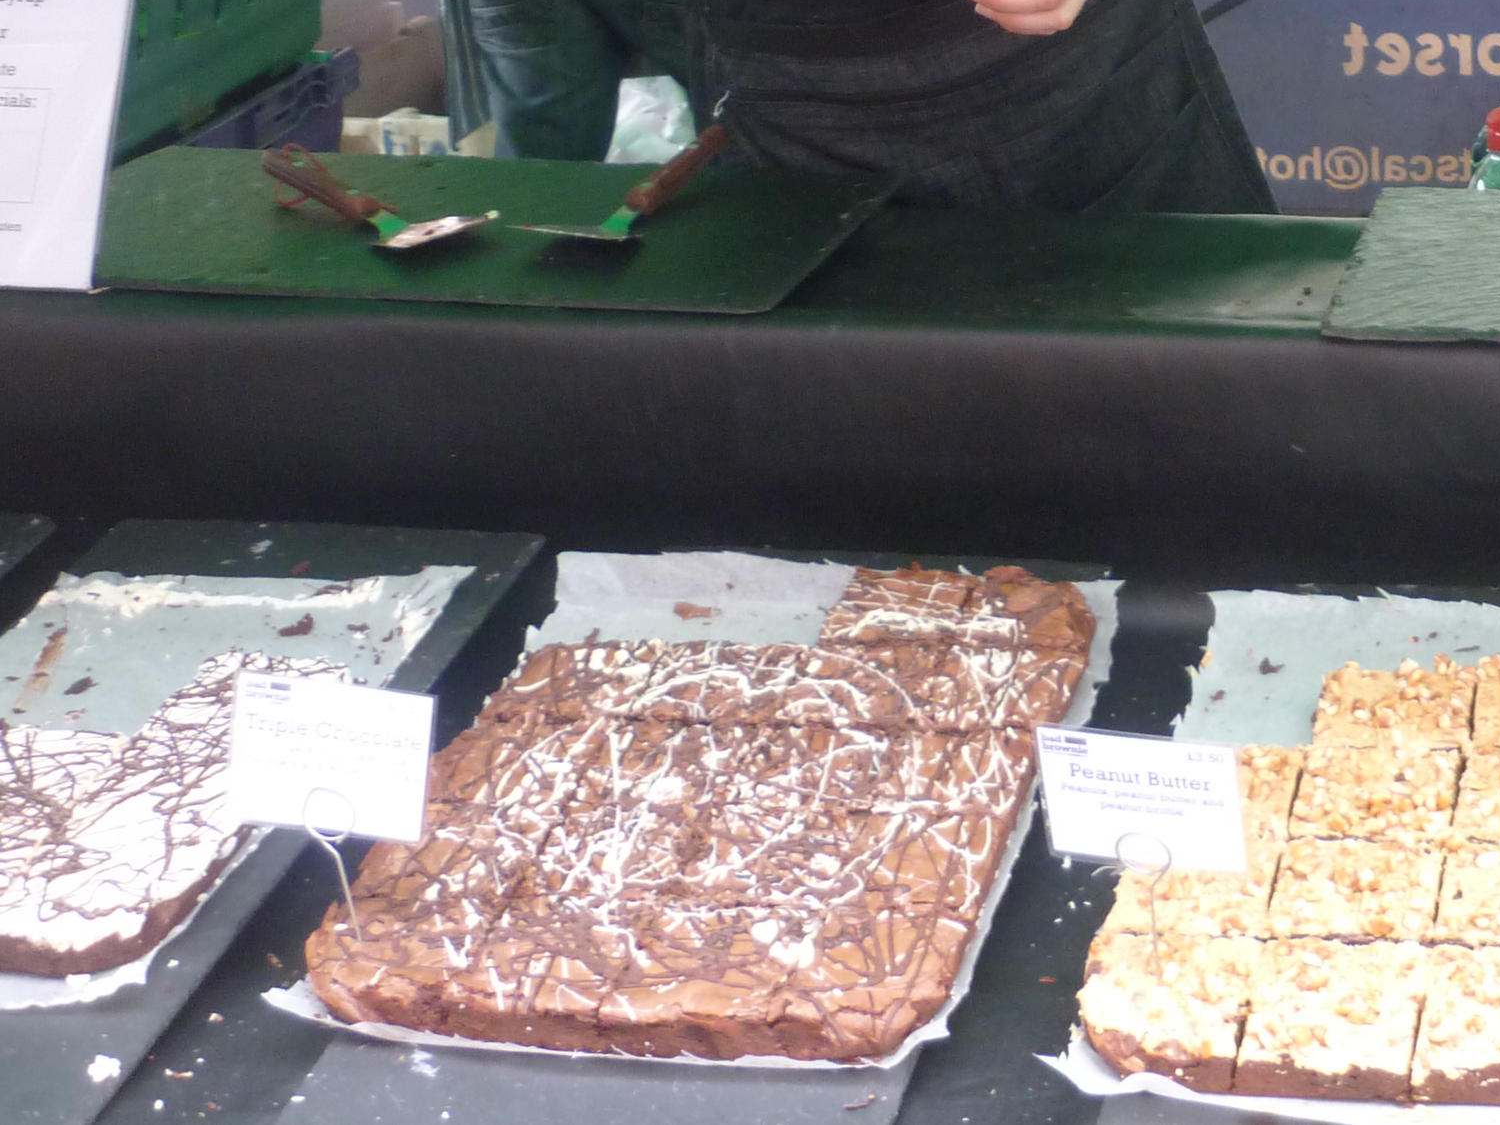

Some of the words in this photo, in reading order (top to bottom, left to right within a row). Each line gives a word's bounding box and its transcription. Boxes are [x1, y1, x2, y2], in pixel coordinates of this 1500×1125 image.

[246, 712, 308, 737] Triple
[316, 721, 422, 751] Chocolate
[1041, 732, 1062, 743] bad
[1042, 740, 1088, 755] brownie
[1187, 751, 1224, 764] £350
[1068, 762, 1141, 785] Peanut
[1147, 771, 1211, 792] Butter
[1202, 798, 1224, 807] and
